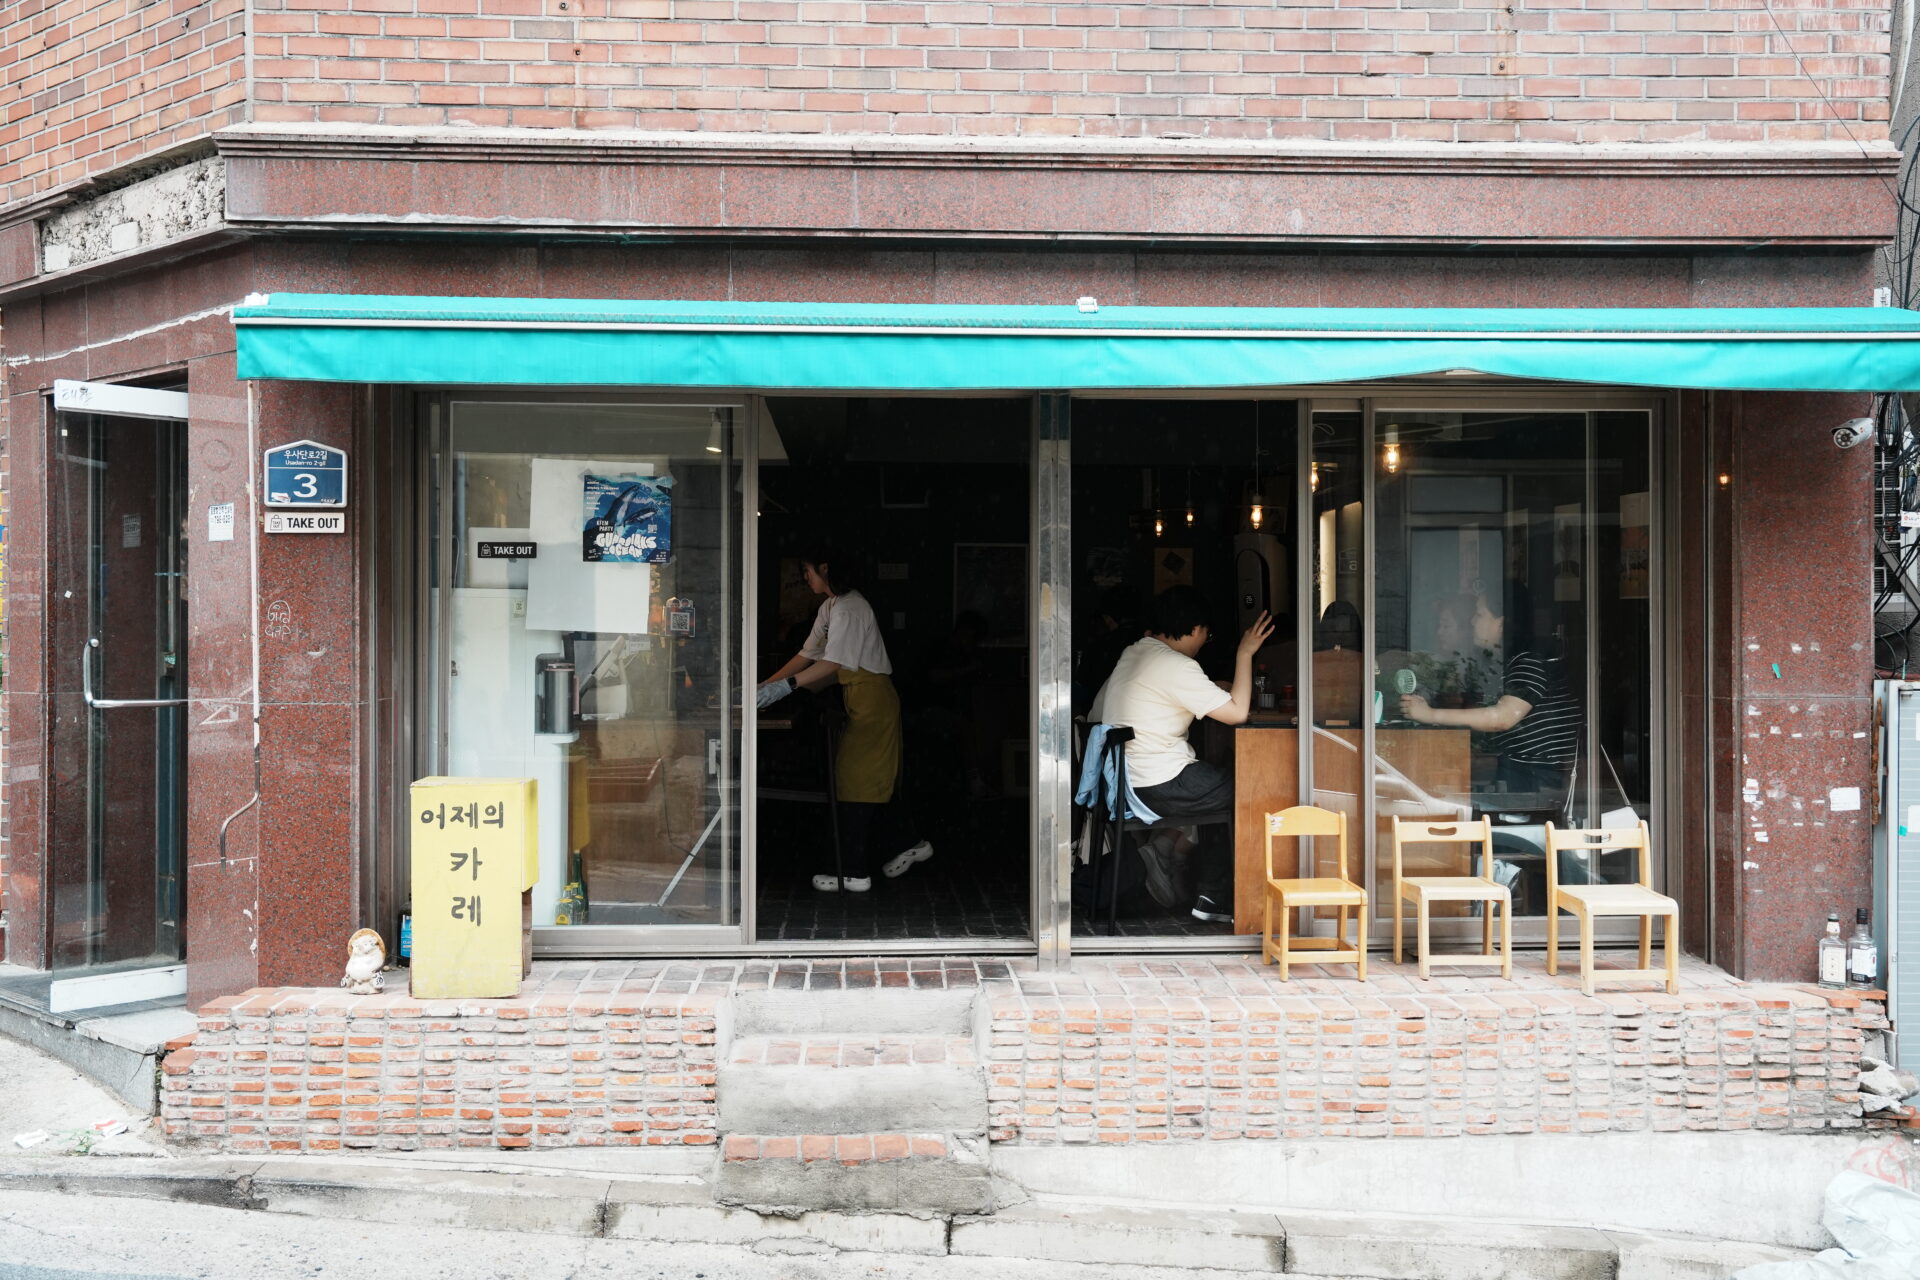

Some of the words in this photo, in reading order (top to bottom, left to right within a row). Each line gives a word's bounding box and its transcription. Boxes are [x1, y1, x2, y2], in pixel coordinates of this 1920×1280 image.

[284, 449, 328, 460] 우사단로2길
[293, 473, 318, 498] 3
[287, 517, 314, 528] TAKE
[317, 517, 339, 528] OUT
[493, 546, 514, 555] TAKE
[516, 546, 533, 555] OUT
[609, 543, 643, 558] OCEAN
[420, 801, 504, 830] 어제의
